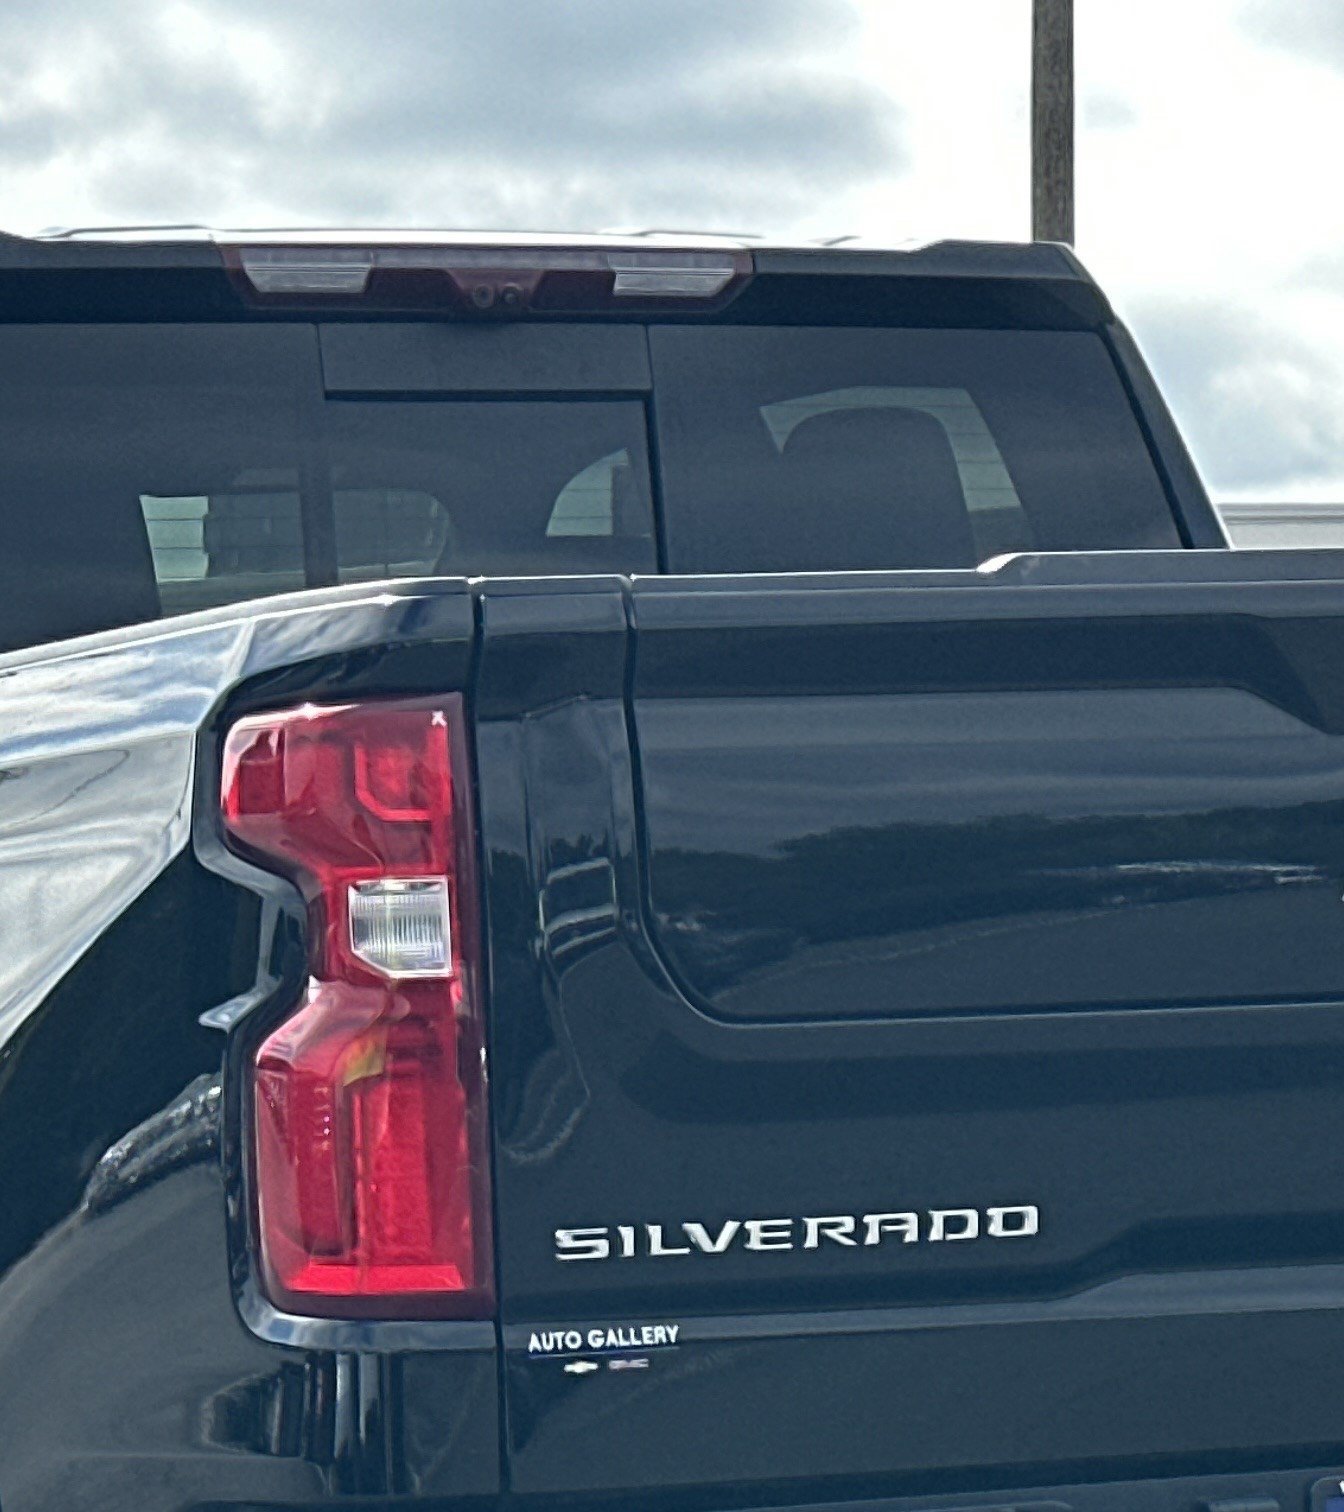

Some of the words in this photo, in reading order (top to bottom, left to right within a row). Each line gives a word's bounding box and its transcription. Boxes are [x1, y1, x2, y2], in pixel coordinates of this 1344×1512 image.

[555, 1205, 1040, 1261] SILVERADO
[528, 1331, 582, 1353] AUTO
[587, 1324, 679, 1349] GALLERY
